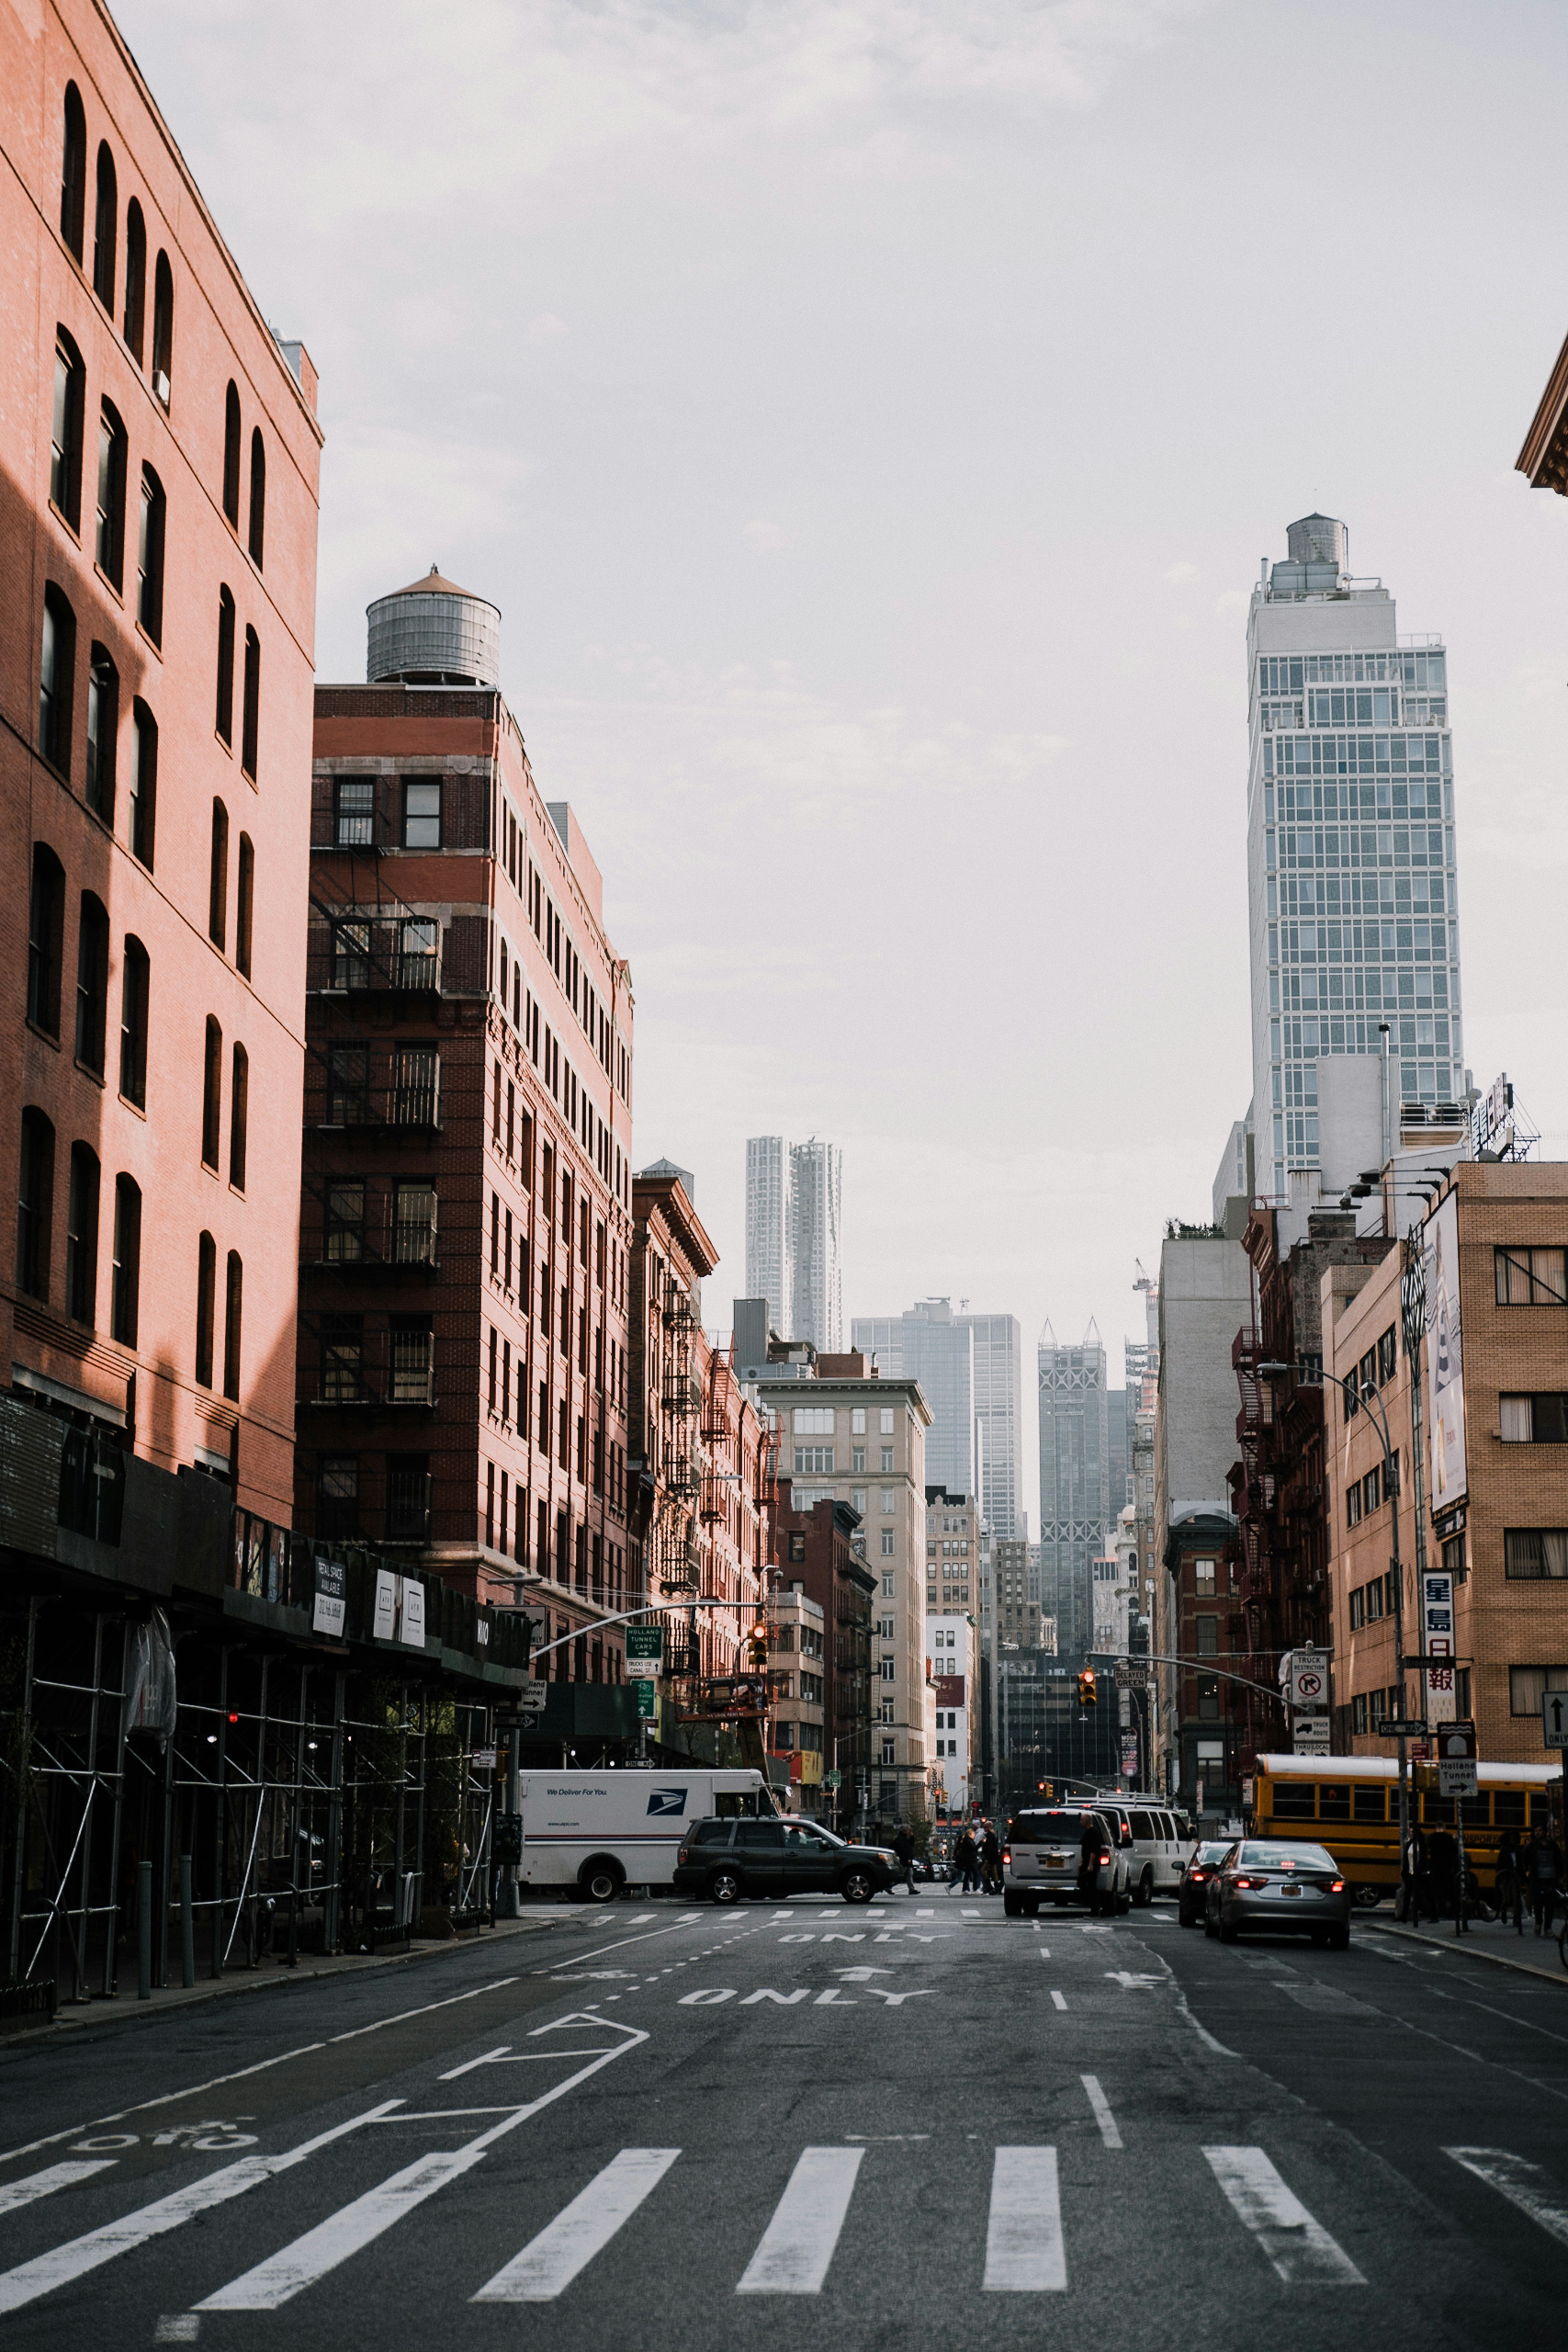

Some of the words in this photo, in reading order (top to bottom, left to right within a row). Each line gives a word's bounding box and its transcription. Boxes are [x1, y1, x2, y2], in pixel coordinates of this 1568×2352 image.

[1426, 1579, 1452, 1690] 星島日報
[1549, 1735, 1568, 1743] ONLY
[777, 1934, 954, 1943] ONLY
[677, 1989, 939, 2005] ONLY
